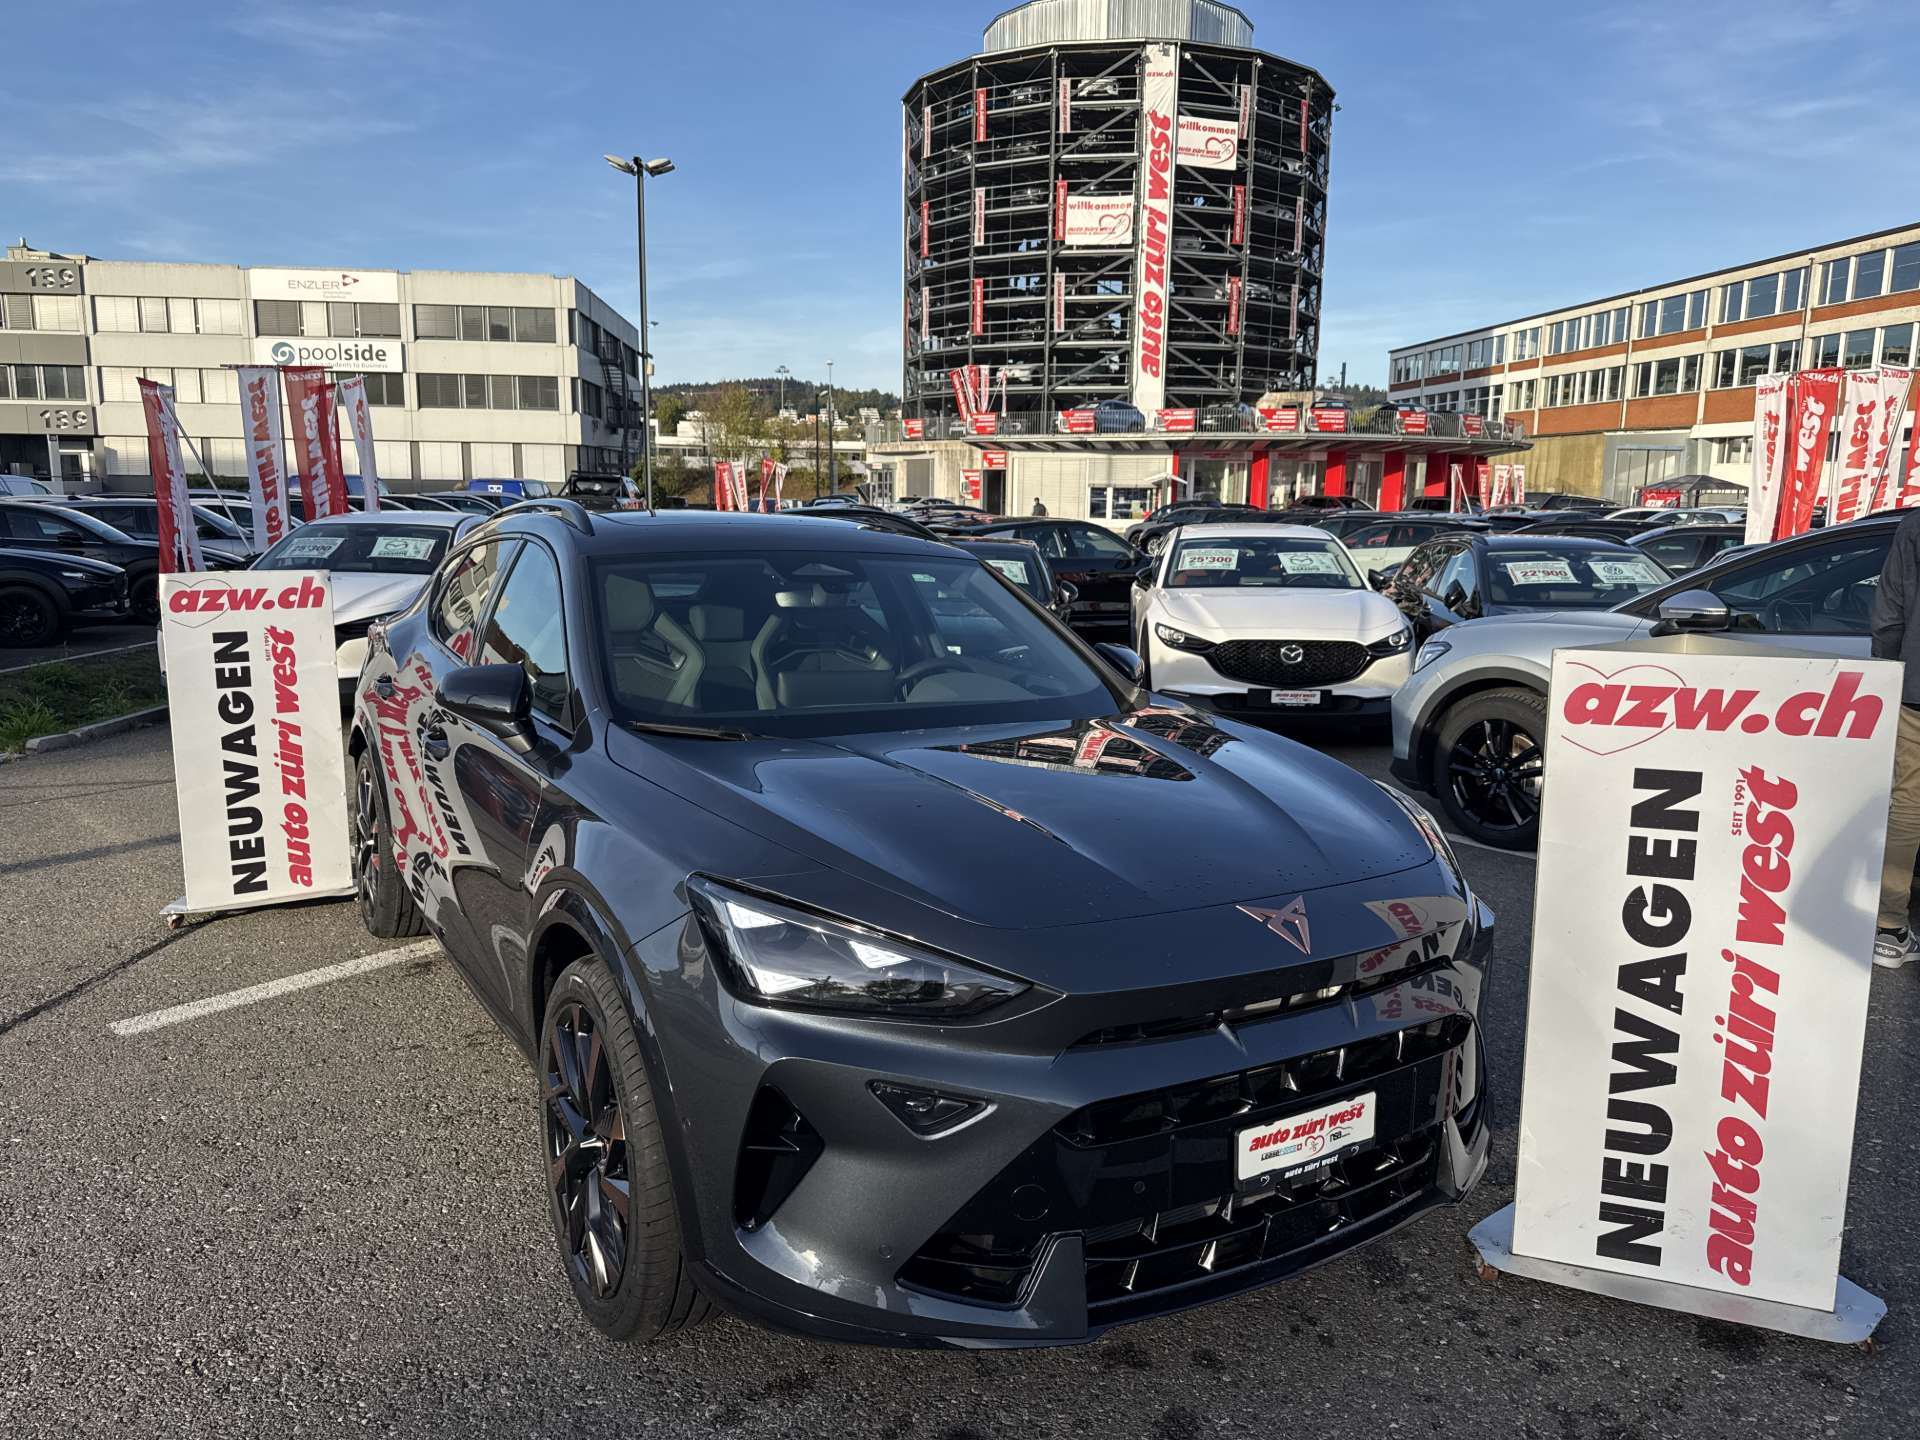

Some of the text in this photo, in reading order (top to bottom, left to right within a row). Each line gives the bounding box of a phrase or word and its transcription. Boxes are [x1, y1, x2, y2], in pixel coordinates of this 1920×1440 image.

[1178, 121, 1237, 136] willkommen
[1068, 201, 1132, 211] willkommen
[1140, 109, 1171, 379] auto züri west
[25, 268, 75, 288] 139
[288, 279, 341, 290] ENZLER
[298, 343, 387, 367] poolside
[40, 409, 88, 429] 139
[1796, 395, 1825, 472] west
[1189, 555, 1232, 564] 25'300
[1520, 569, 1568, 578] 22'900
[169, 576, 325, 613] azw.ch
[1563, 671, 1883, 739] azw.ch
[212, 631, 268, 895] NEUWAGEN
[264, 625, 313, 887] auto züri west
[1731, 778, 1746, 836] SEIT 1991
[1596, 768, 1703, 1267] NEUWAGEN
[1703, 765, 1798, 1287] auto züri west
[1249, 1102, 1365, 1152] auto züri west
[1284, 1154, 1339, 1179] auto züri west
